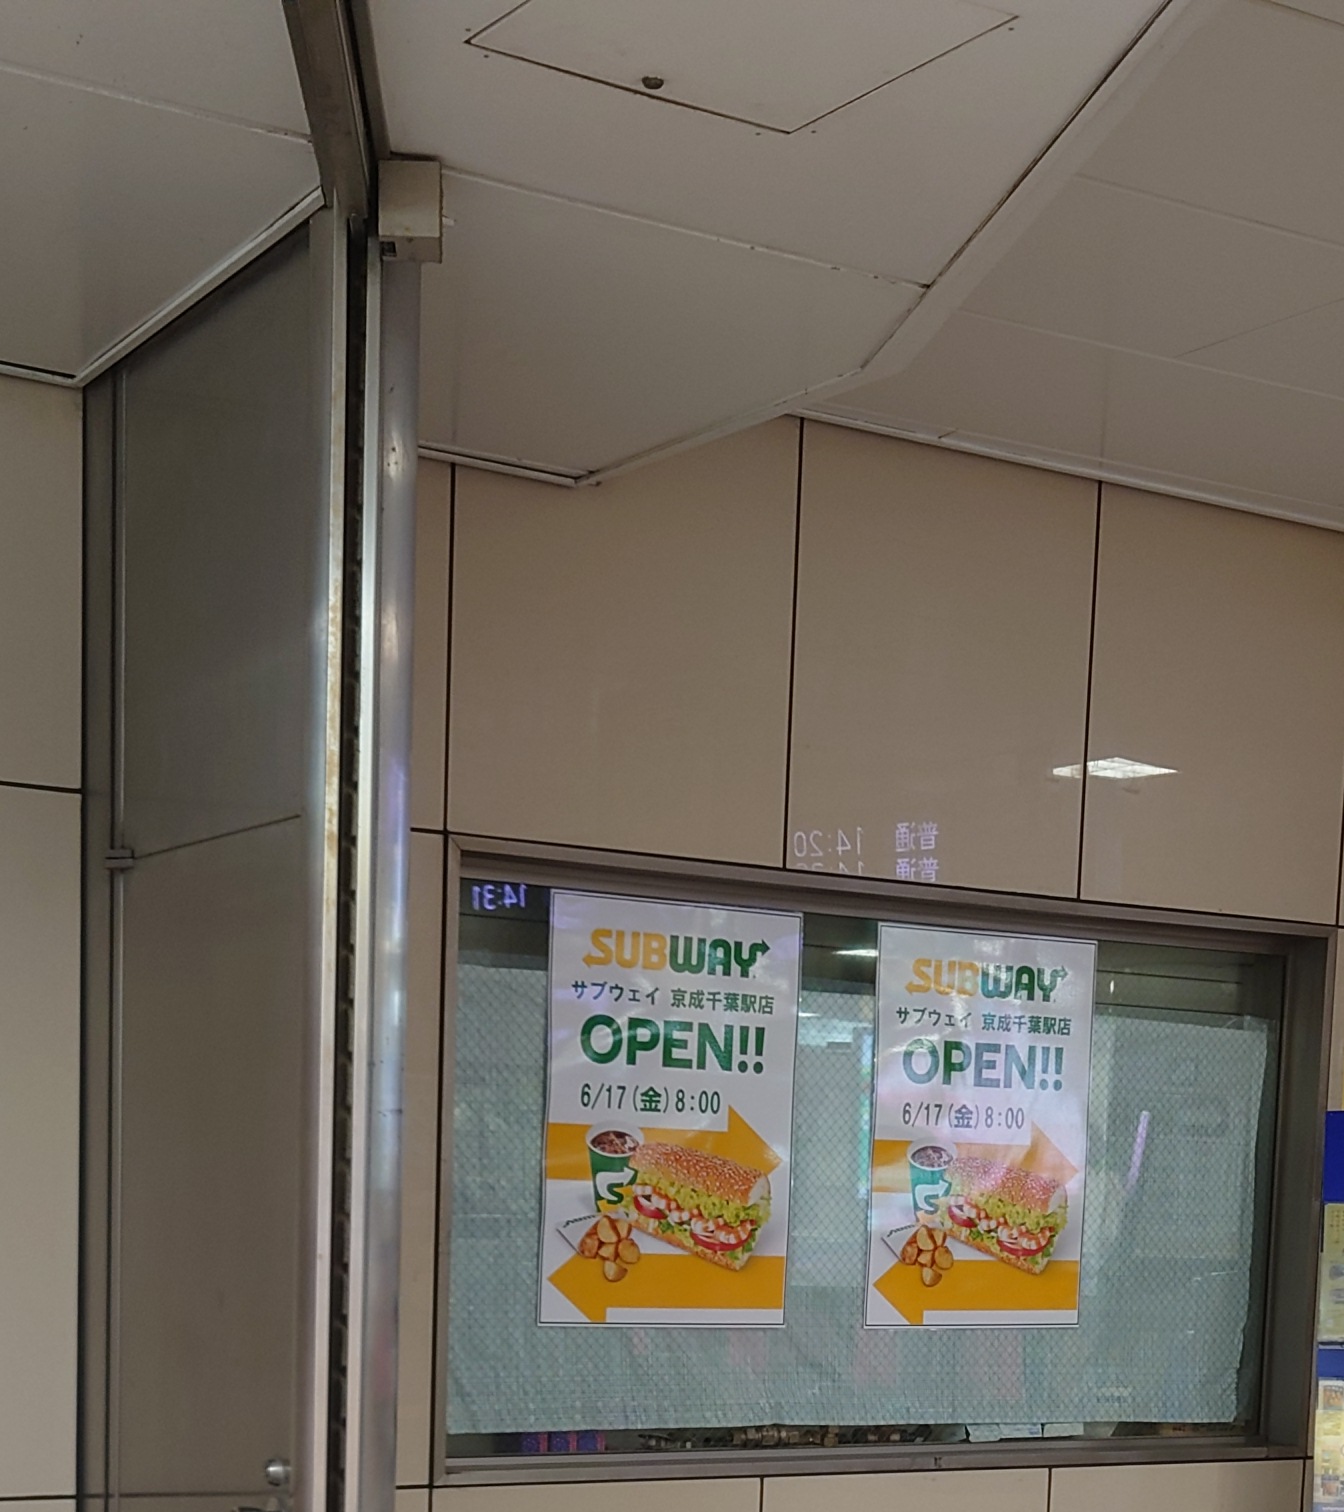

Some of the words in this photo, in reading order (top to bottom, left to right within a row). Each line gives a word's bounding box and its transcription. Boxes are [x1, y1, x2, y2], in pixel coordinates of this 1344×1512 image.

[582, 928, 771, 978] SUBWAY
[571, 980, 660, 1005] サブウェイ
[670, 988, 775, 1015] 京成千葉駅店
[905, 957, 1069, 1003] SUBWAY
[580, 1013, 766, 1074] OPEN!!
[896, 1007, 972, 1028] サブウェイ
[982, 1012, 1071, 1036] 京成千葉駅店
[902, 1038, 1064, 1091] OPEN!!
